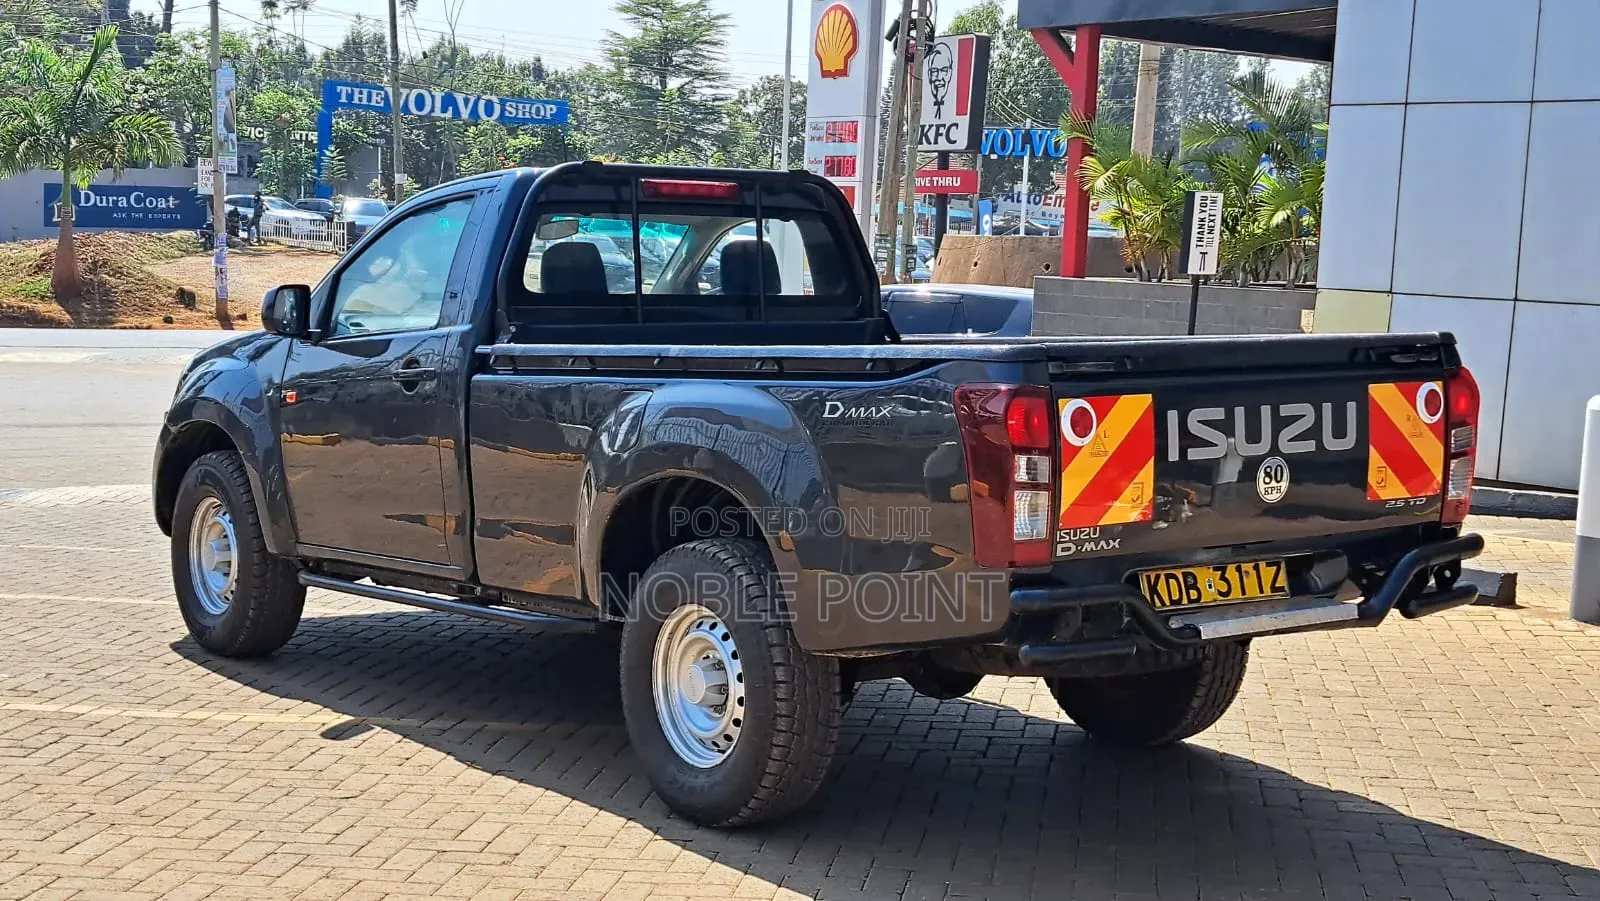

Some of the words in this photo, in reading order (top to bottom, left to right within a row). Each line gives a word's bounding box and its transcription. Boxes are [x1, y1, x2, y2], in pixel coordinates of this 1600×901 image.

[336, 85, 385, 107] THE
[384, 87, 501, 121] VOLVO
[504, 101, 557, 120] SHOP
[917, 122, 959, 145] KFC
[981, 128, 1067, 158] VOLVO
[914, 176, 930, 187] RIVE
[932, 176, 961, 187] THRU
[79, 190, 176, 209] DuraCoat
[1198, 195, 1209, 214] YOU
[1209, 195, 1218, 211] TIME
[1196, 216, 1207, 248] THANK
[1207, 212, 1217, 235] NEXT
[1167, 401, 1357, 462] ISUZU
[1262, 464, 1284, 486] 80
[1263, 486, 1282, 496] KPH
[1056, 526, 1100, 542] ISUZU
[1145, 571, 1202, 608] KDB
[1213, 561, 1286, 599] 311Z
